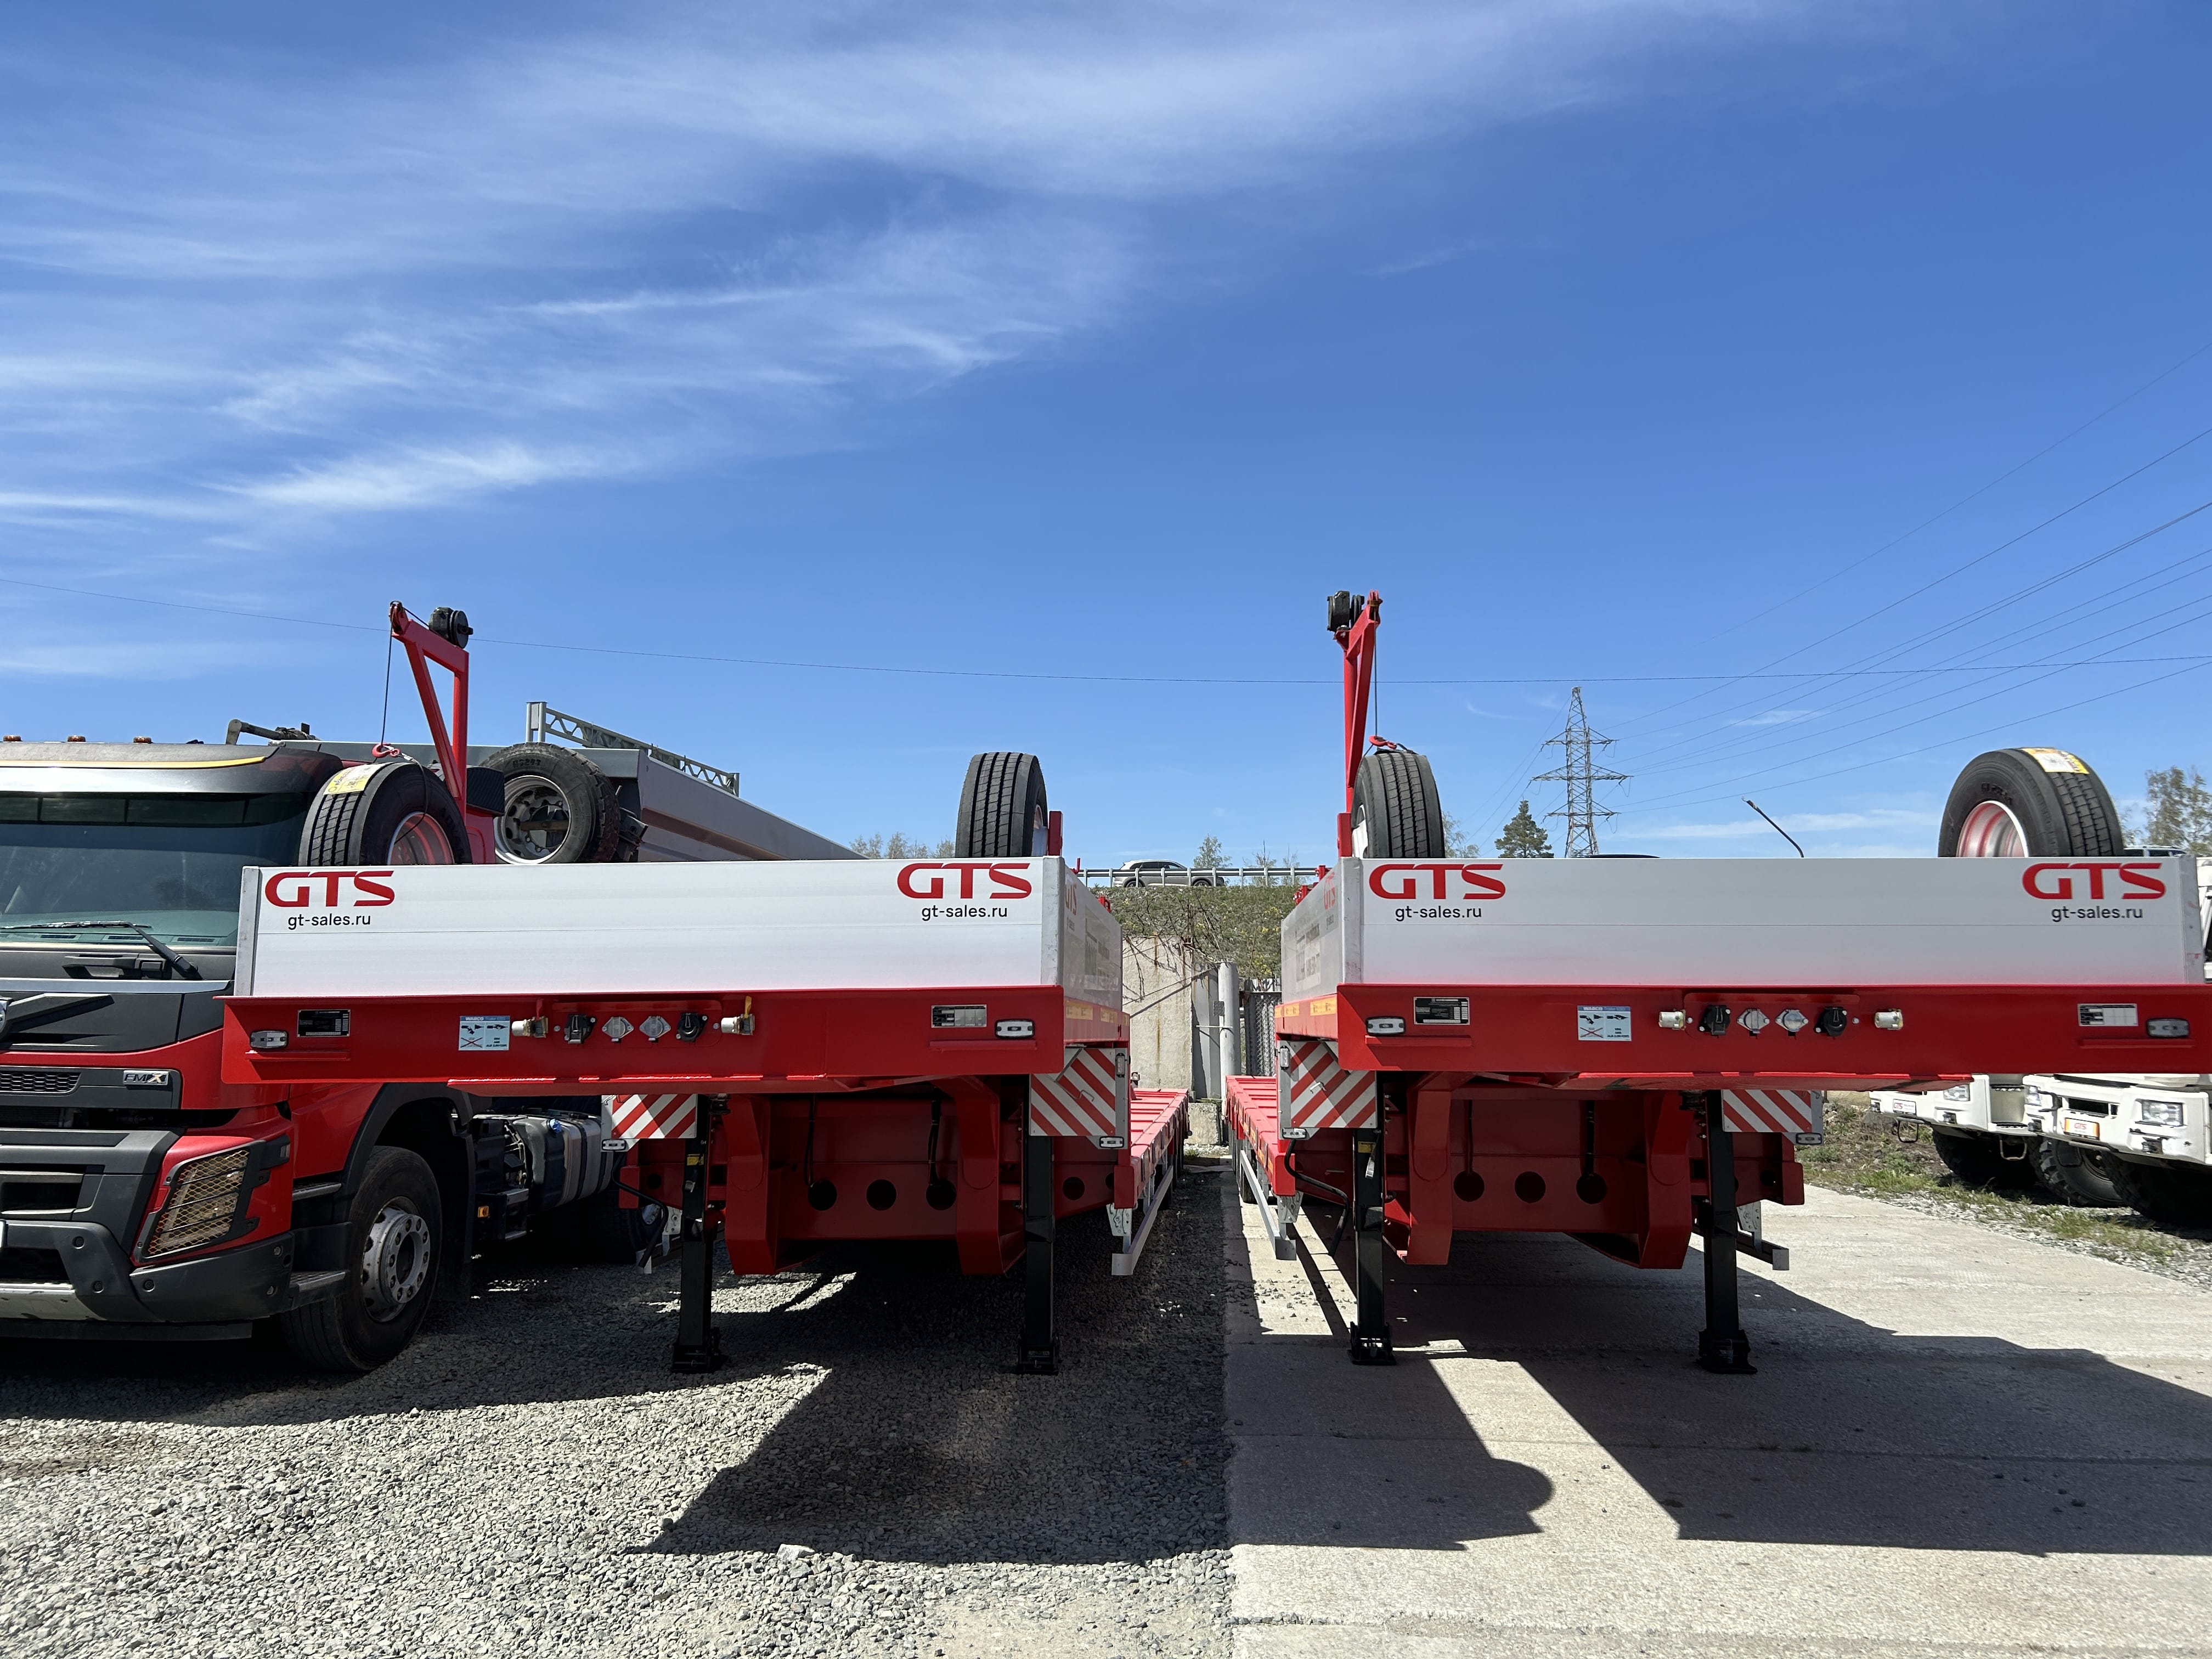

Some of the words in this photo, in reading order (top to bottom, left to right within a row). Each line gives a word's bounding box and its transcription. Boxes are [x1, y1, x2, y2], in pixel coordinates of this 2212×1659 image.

[266, 871, 394, 907] GTS
[898, 863, 1031, 899] GTS
[1369, 864, 1505, 899] GTS
[2022, 863, 2165, 899] GTS
[288, 913, 371, 930] gt-sales.ru
[922, 905, 1007, 921] gt-sales.ru
[1395, 905, 1482, 922] gt-sales.ru
[2051, 906, 2143, 922] gt-sales.ru
[124, 1073, 164, 1084] FMX
